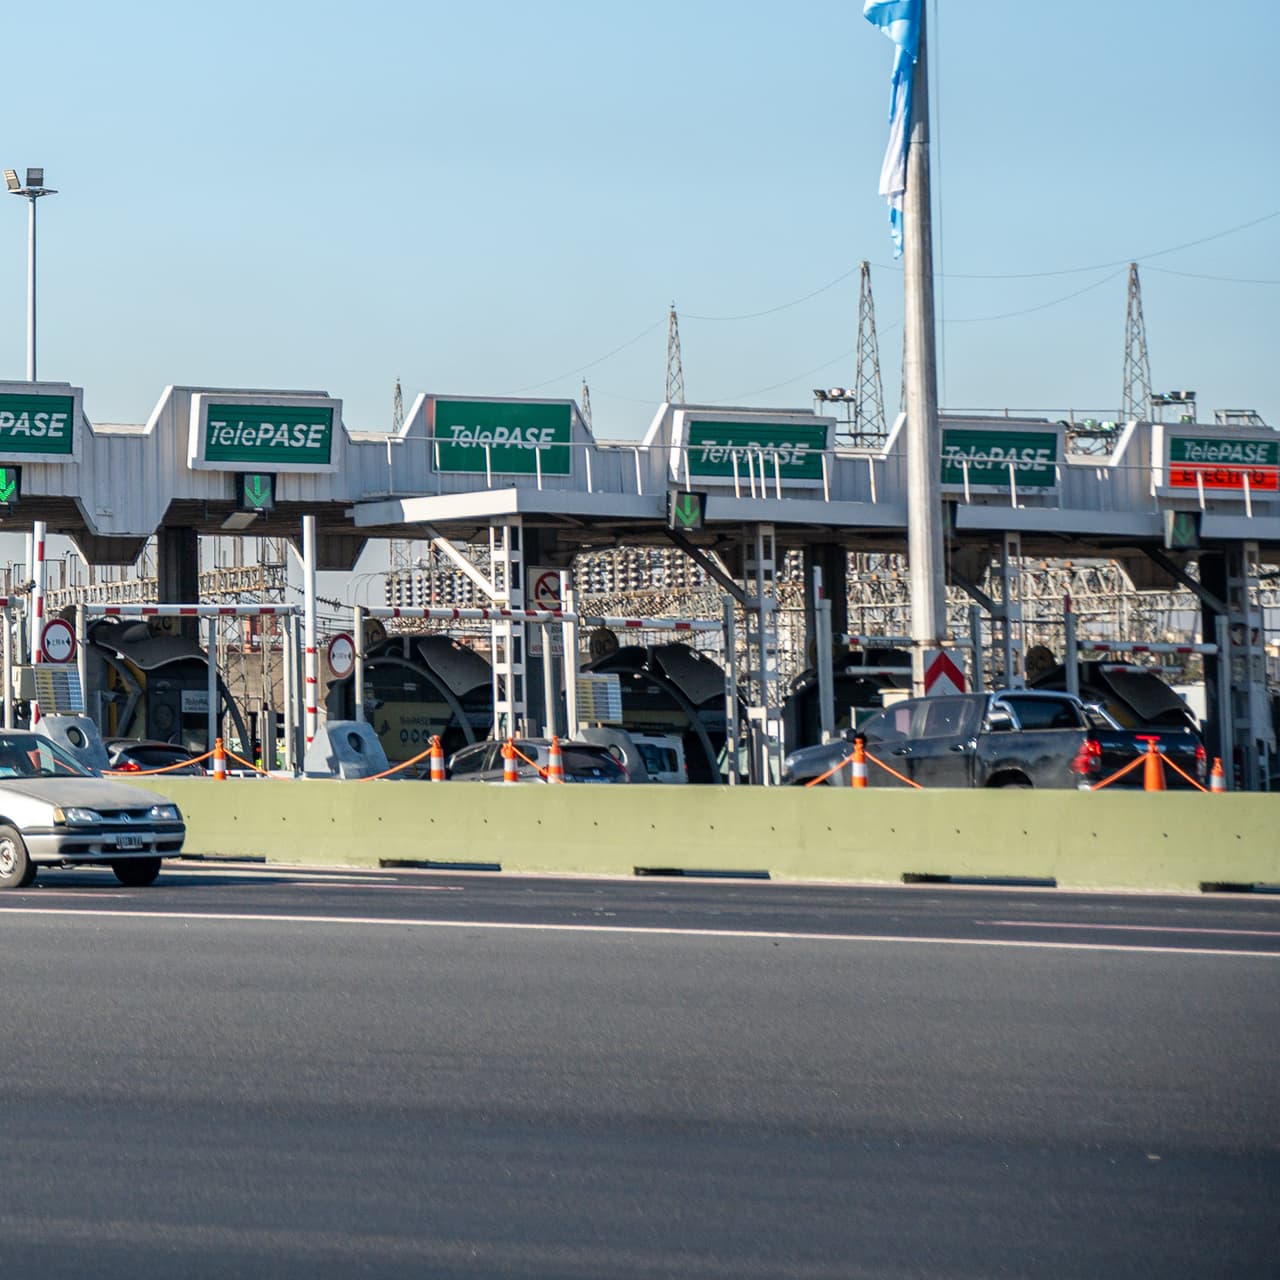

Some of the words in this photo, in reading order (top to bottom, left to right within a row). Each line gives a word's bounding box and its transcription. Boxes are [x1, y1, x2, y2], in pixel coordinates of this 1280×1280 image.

[210, 421, 326, 448] TelePASE
[450, 425, 555, 449] TelePASE
[1184, 441, 1270, 463] TelePASE
